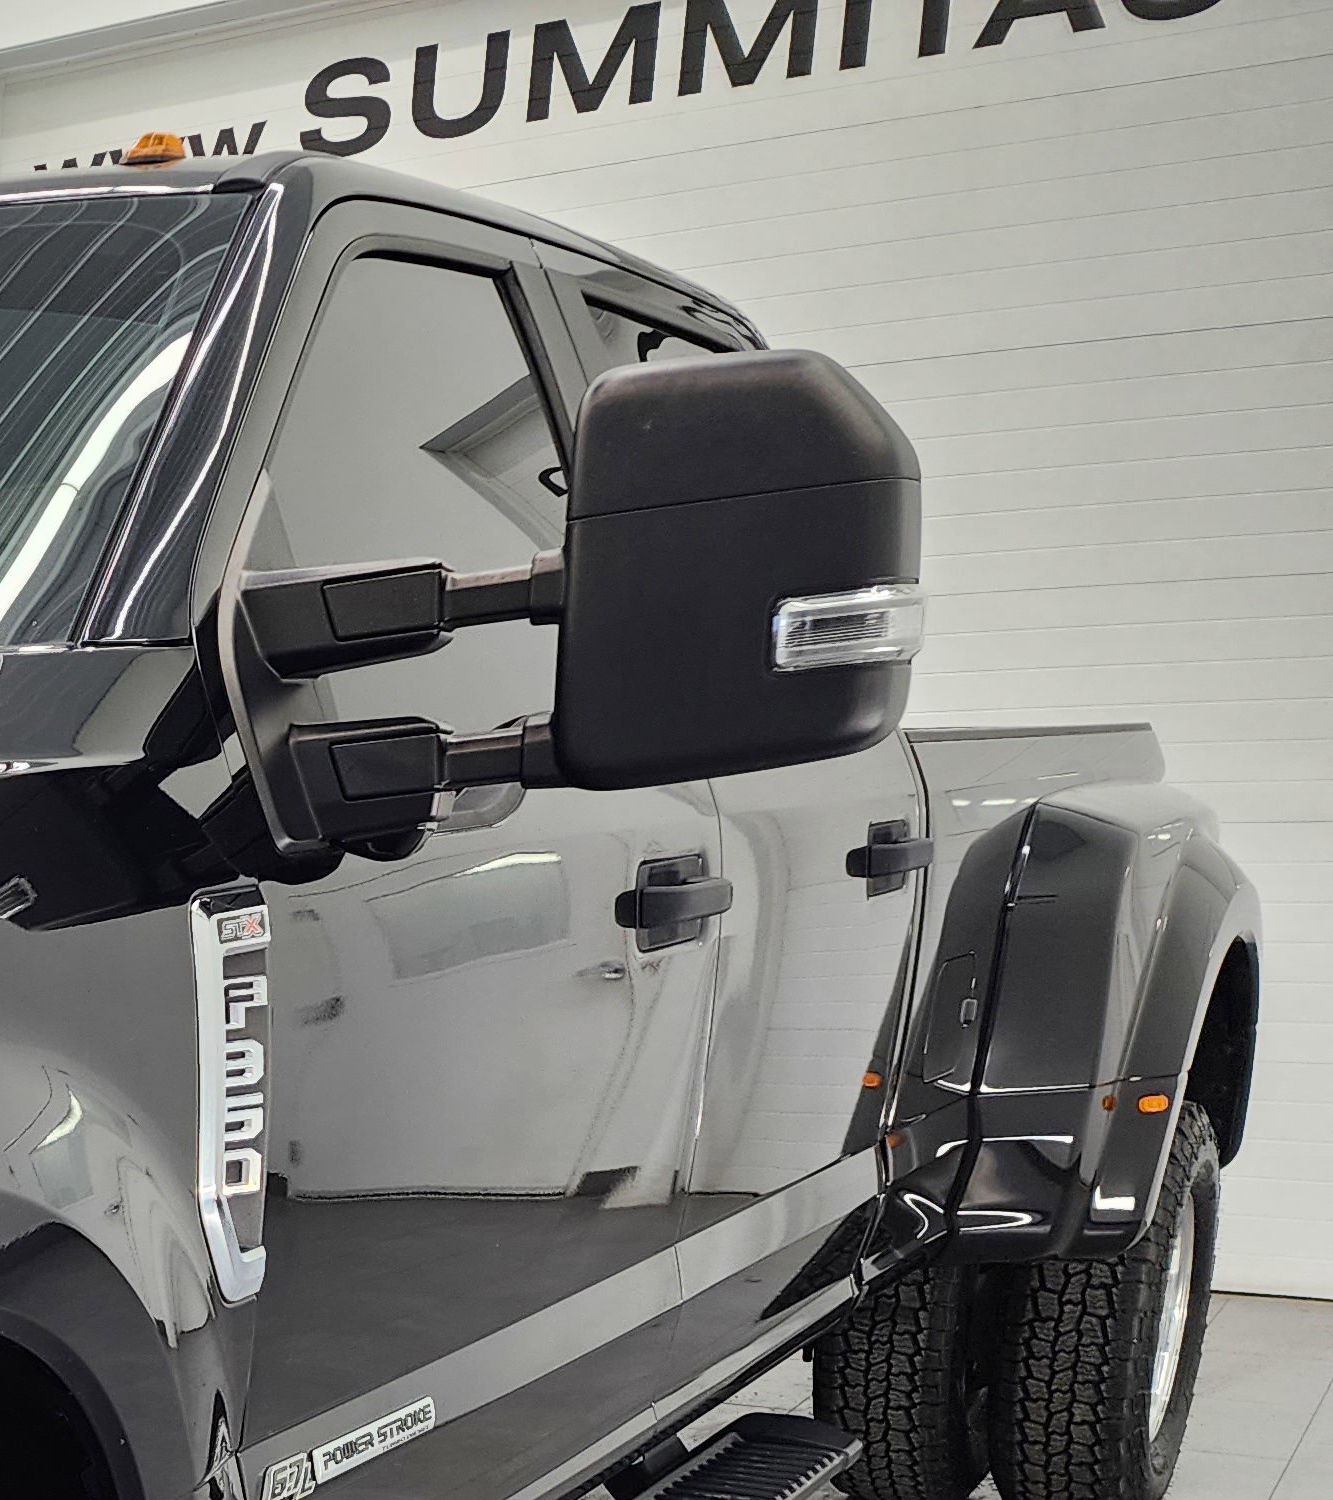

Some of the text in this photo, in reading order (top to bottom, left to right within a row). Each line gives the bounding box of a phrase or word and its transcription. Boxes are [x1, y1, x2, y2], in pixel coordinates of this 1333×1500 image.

[299, 0, 1225, 157] SUMMITA
[322, 1431, 375, 1472] POWER
[377, 1403, 433, 1444] STROKE
